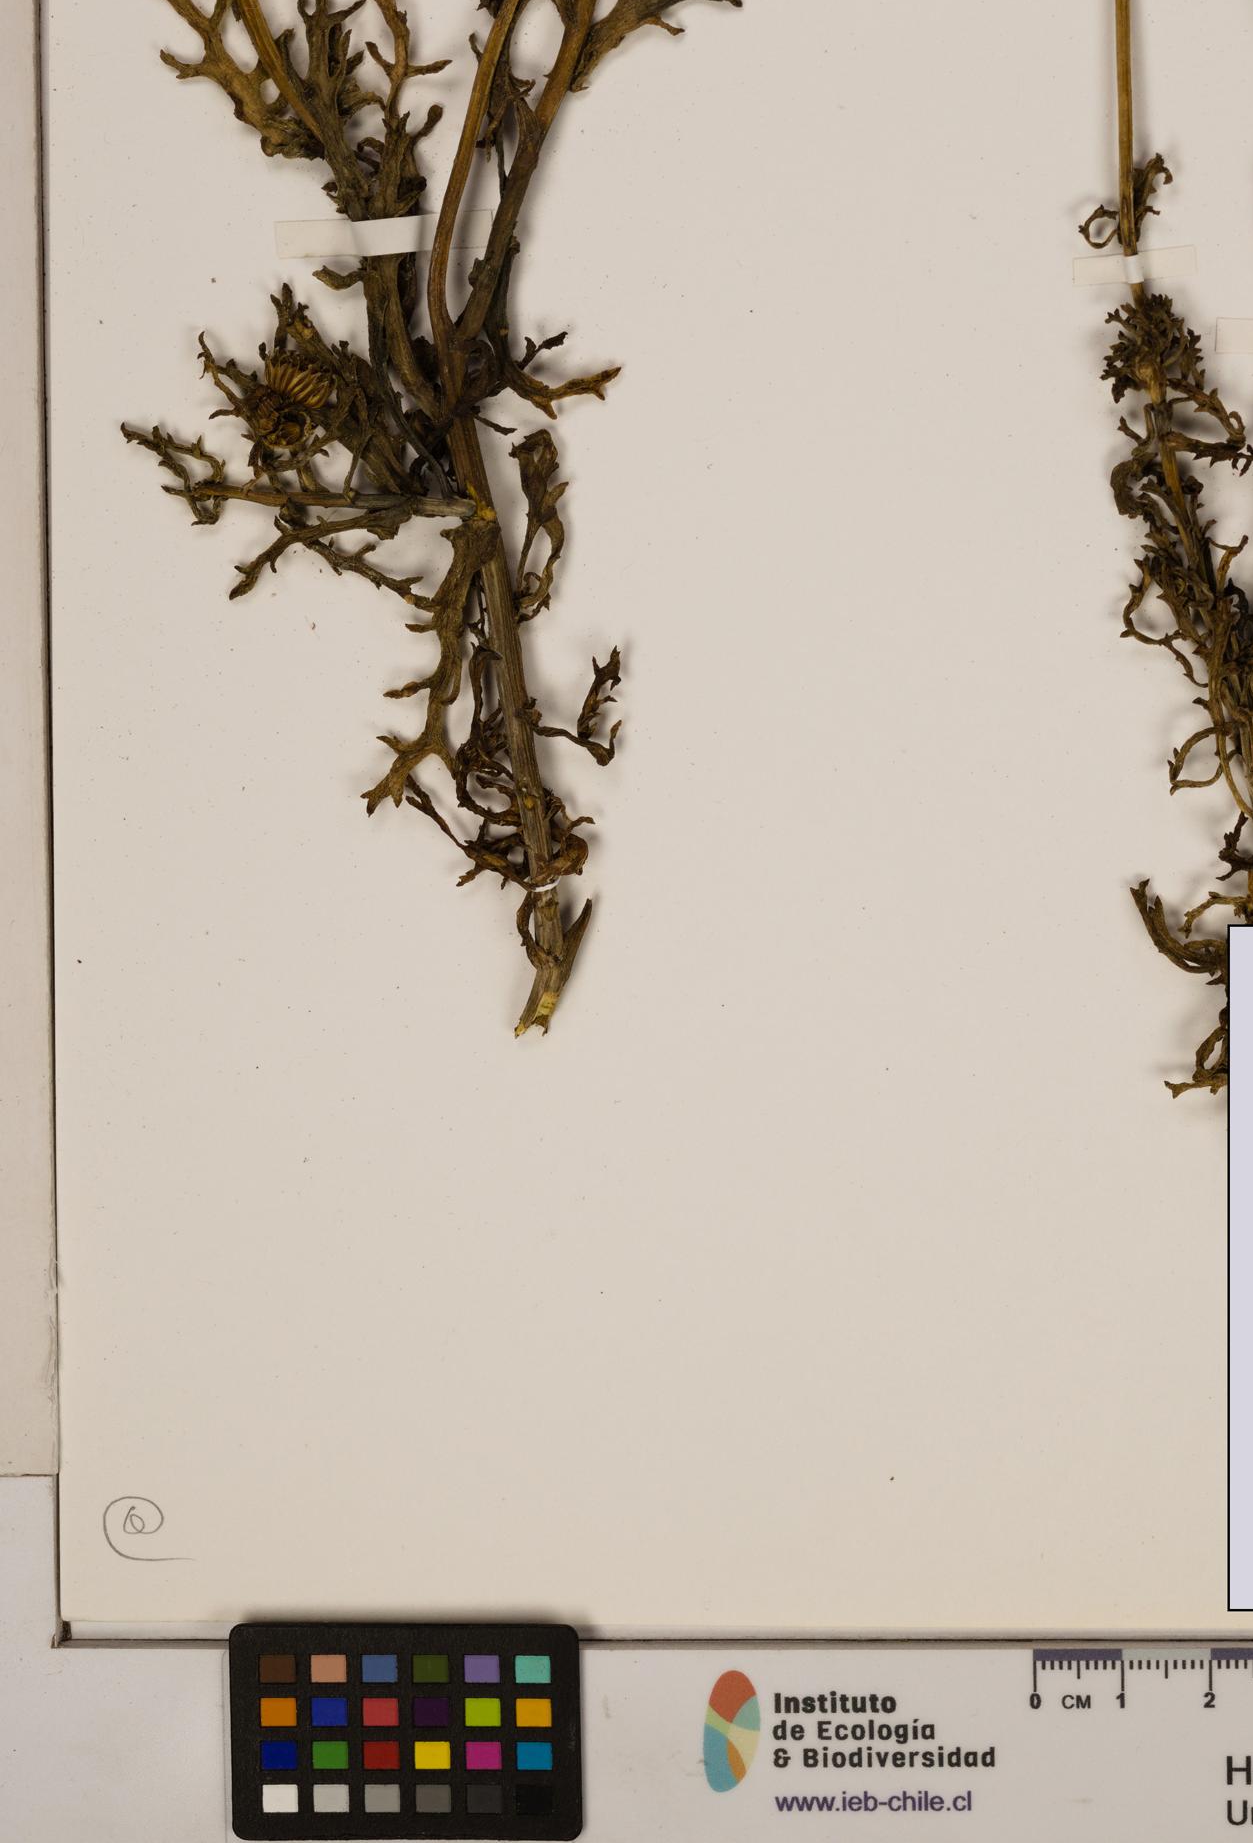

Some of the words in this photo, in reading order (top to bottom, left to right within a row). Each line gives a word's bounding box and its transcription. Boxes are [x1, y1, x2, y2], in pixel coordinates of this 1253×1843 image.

[775, 1691, 896, 1713] Instituto
[1030, 1693, 1041, 1709] 0
[1062, 1695, 1090, 1709] CM
[1116, 1693, 1125, 1708] 1
[1204, 1692, 1215, 1708] 2
[773, 1720, 804, 1740] de
[818, 1718, 936, 1744] Ecología
[774, 1748, 791, 1768] &
[803, 1747, 995, 1768] Biodiversidad
[775, 1791, 971, 1812] www.ieb-chile.cl
